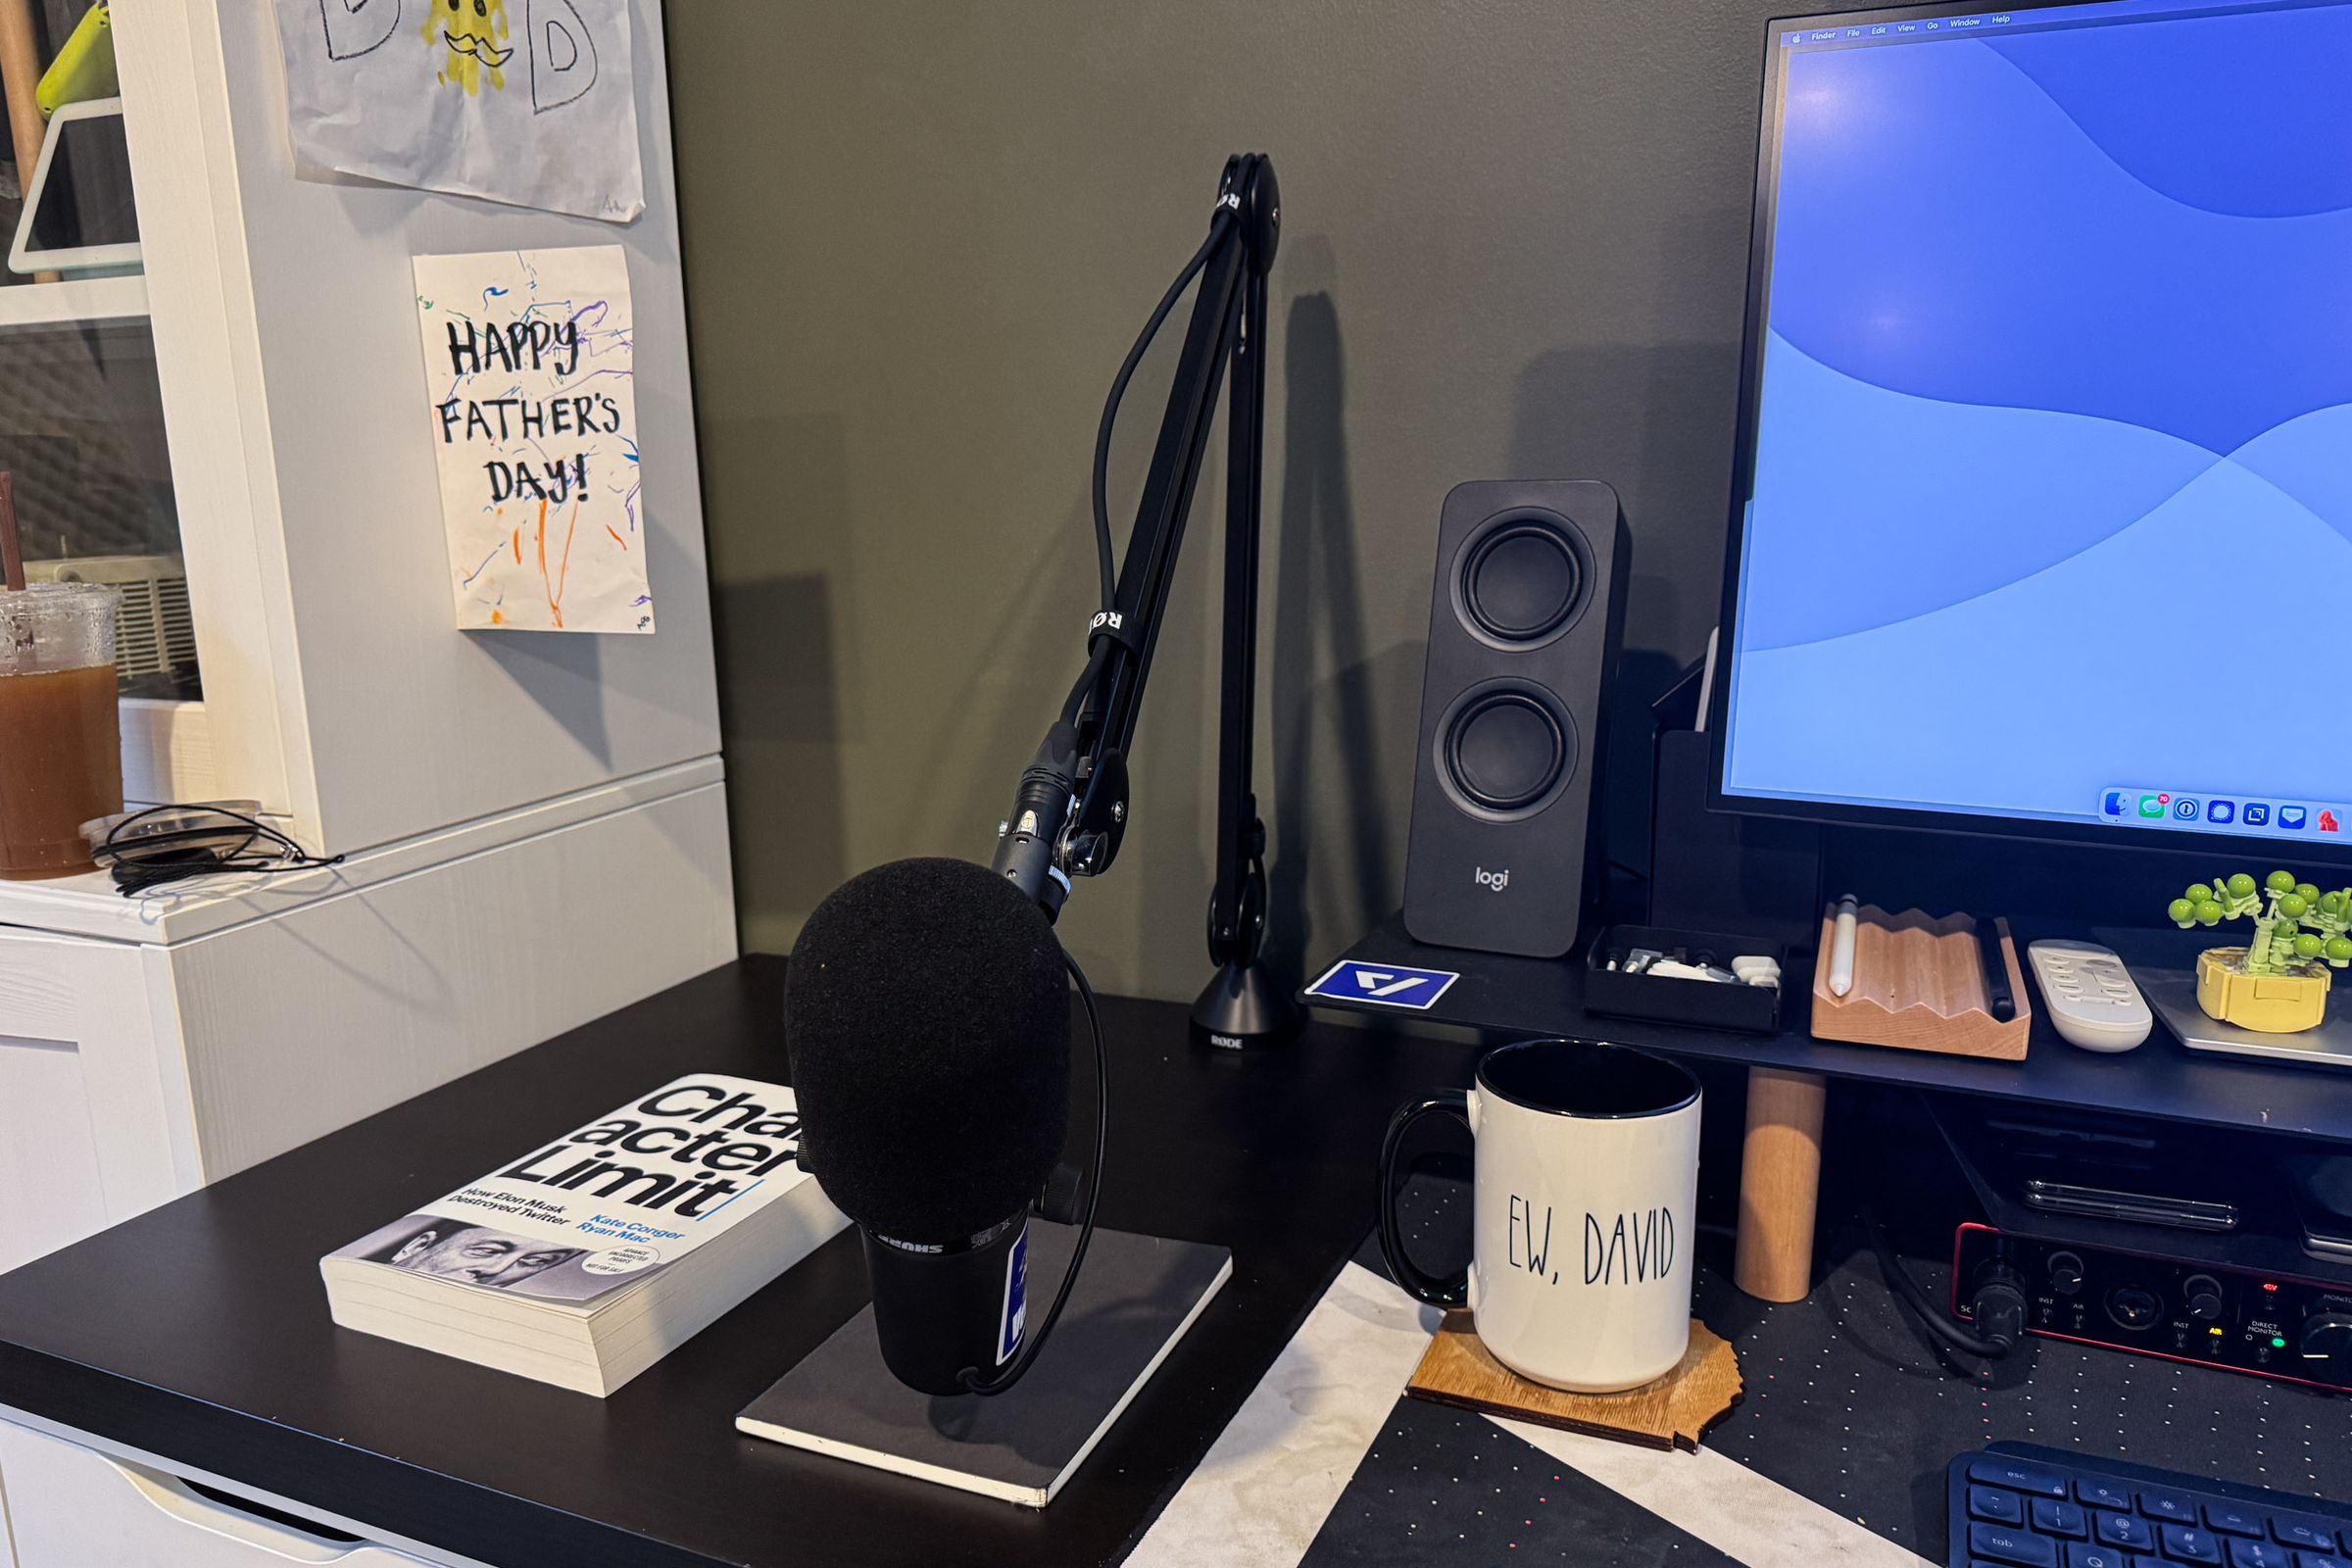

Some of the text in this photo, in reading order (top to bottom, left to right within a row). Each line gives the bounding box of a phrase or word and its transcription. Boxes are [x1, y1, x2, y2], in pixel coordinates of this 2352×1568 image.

[1811, 31, 1837, 40] Finder
[1871, 26, 1886, 35] Edit
[1950, 18, 1981, 27] Window
[1991, 15, 2011, 24] Help
[446, 319, 578, 376] HAPPY
[435, 392, 621, 444] FATHER'S
[483, 453, 589, 504] DAY!
[1475, 866, 1509, 892] logi
[638, 1086, 802, 1141] Cha
[568, 1120, 799, 1176] acter
[496, 1145, 740, 1217] Limit
[447, 1195, 571, 1225] Destroyed Twitter
[462, 1188, 567, 1214] How Elon Musk
[576, 1222, 651, 1244] Ryan Mac
[590, 1213, 686, 1240] Kate Conger
[877, 1234, 944, 1253] SHURE
[1509, 1194, 1674, 1285] EW, DAVID
[2173, 1321, 2190, 1330] INST
[2209, 1327, 2223, 1336] AIR
[2247, 1325, 2283, 1338] MONITOR
[2251, 1320, 2278, 1331] DIRECT
[2007, 1471, 2027, 1481] esc
[1991, 1537, 2014, 1548] tab
[2120, 1531, 2130, 1541] 2
[2086, 1556, 2104, 1568] Q
